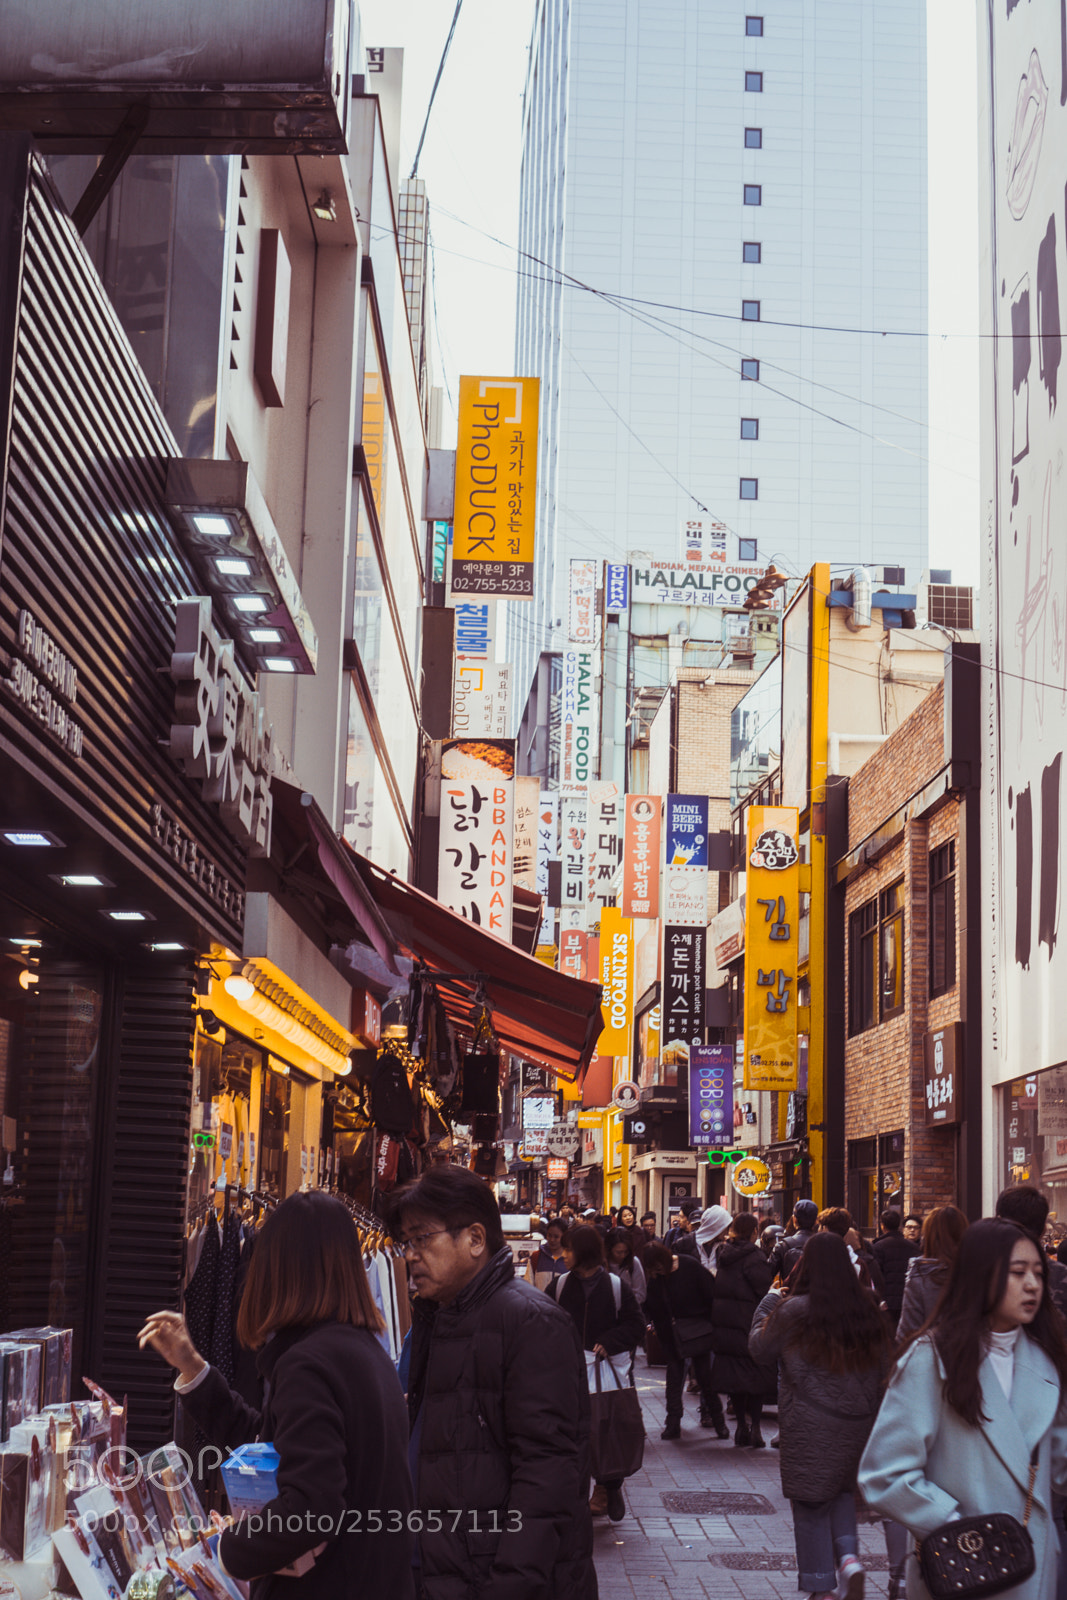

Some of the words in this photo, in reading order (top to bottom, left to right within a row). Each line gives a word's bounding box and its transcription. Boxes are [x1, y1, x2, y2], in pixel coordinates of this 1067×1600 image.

[508, 430, 526, 477] 고기가
[467, 401, 500, 554] PhoDUCK
[506, 482, 525, 533] 맛있는
[506, 537, 521, 555] 집
[462, 562, 503, 576] 예약문의
[508, 564, 525, 577] 3F
[650, 561, 687, 572] INDIAN,
[688, 564, 724, 574] NEPALI,
[453, 577, 531, 592] 02-755-5233
[608, 565, 626, 608] GURKHA
[634, 569, 760, 593] HALALFOO
[657, 588, 698, 603] 구르카
[564, 652, 576, 723] GURKHA
[576, 653, 592, 716] HALAL
[575, 726, 590, 782] FOOD
[672, 804, 699, 814] MINI
[672, 814, 703, 824] BEER
[672, 823, 695, 833] PUB
[489, 787, 506, 929] BBANDAK
[632, 823, 651, 898] 홍콩반점
[566, 854, 585, 901] 갈비
[670, 934, 692, 946] 수제
[694, 934, 703, 974] Homemade
[756, 895, 793, 1014] 김밥
[611, 933, 628, 1030] SKINFOOD
[670, 948, 691, 1013] 돈까스
[693, 975, 703, 991] pork
[602, 985, 611, 1008] 1957
[693, 992, 702, 1014] cutlet
[551, 1127, 576, 1136] 의정부
[630, 1120, 646, 1134] 10
